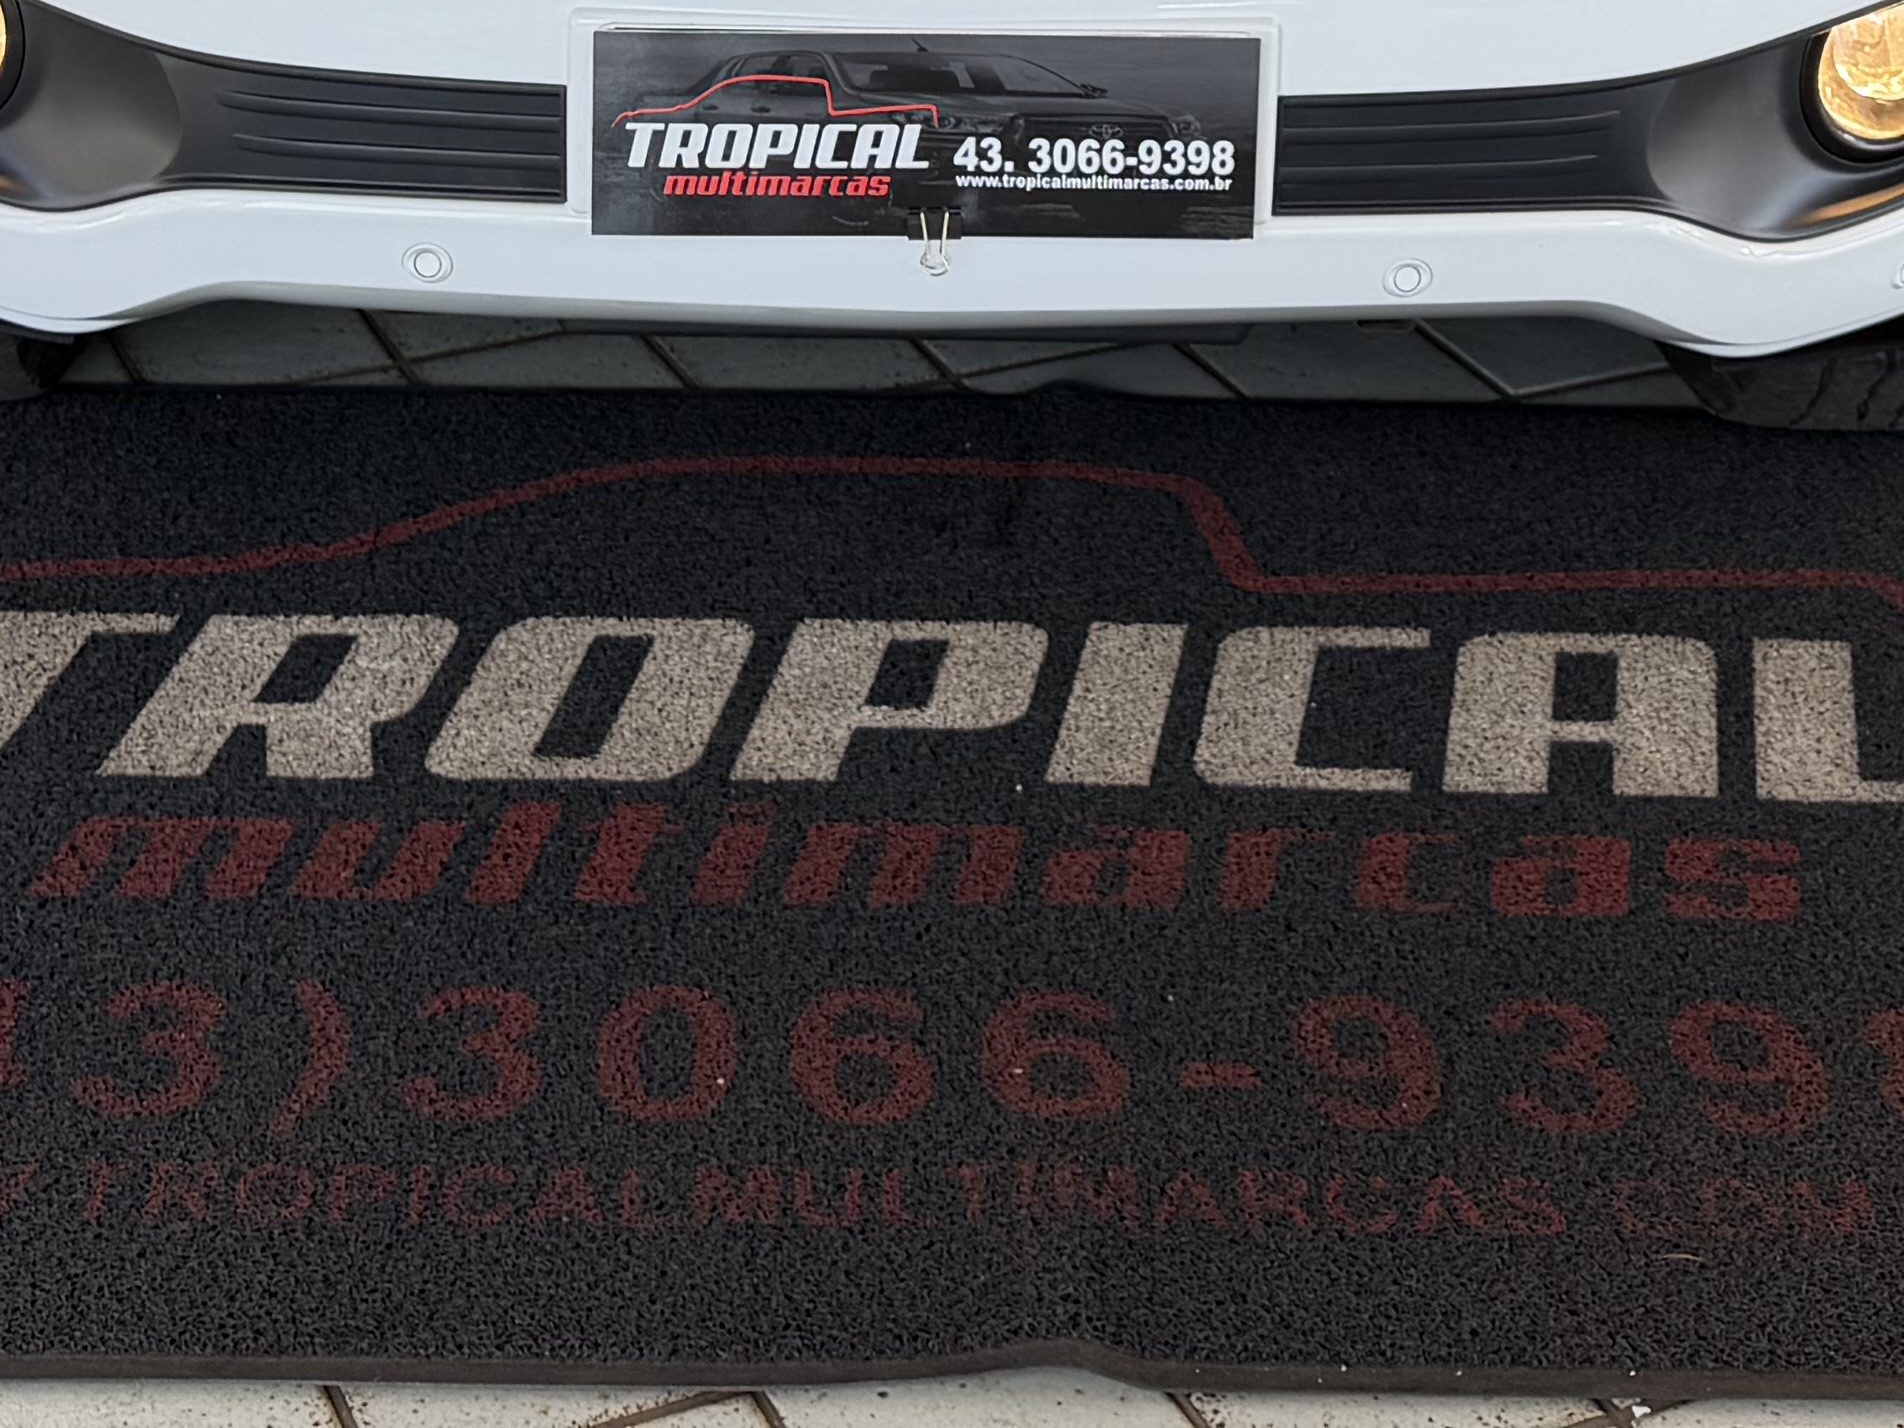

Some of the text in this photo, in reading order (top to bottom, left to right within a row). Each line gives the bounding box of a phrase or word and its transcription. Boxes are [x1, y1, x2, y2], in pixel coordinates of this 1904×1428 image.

[625, 122, 930, 169] TROPICAL
[953, 136, 1236, 176] 43. 3066-9398
[663, 170, 891, 197] multimarcas
[955, 174, 1233, 191] www.tropicalmultimarcas.com.br
[31, 799, 1804, 920] multimarcas
